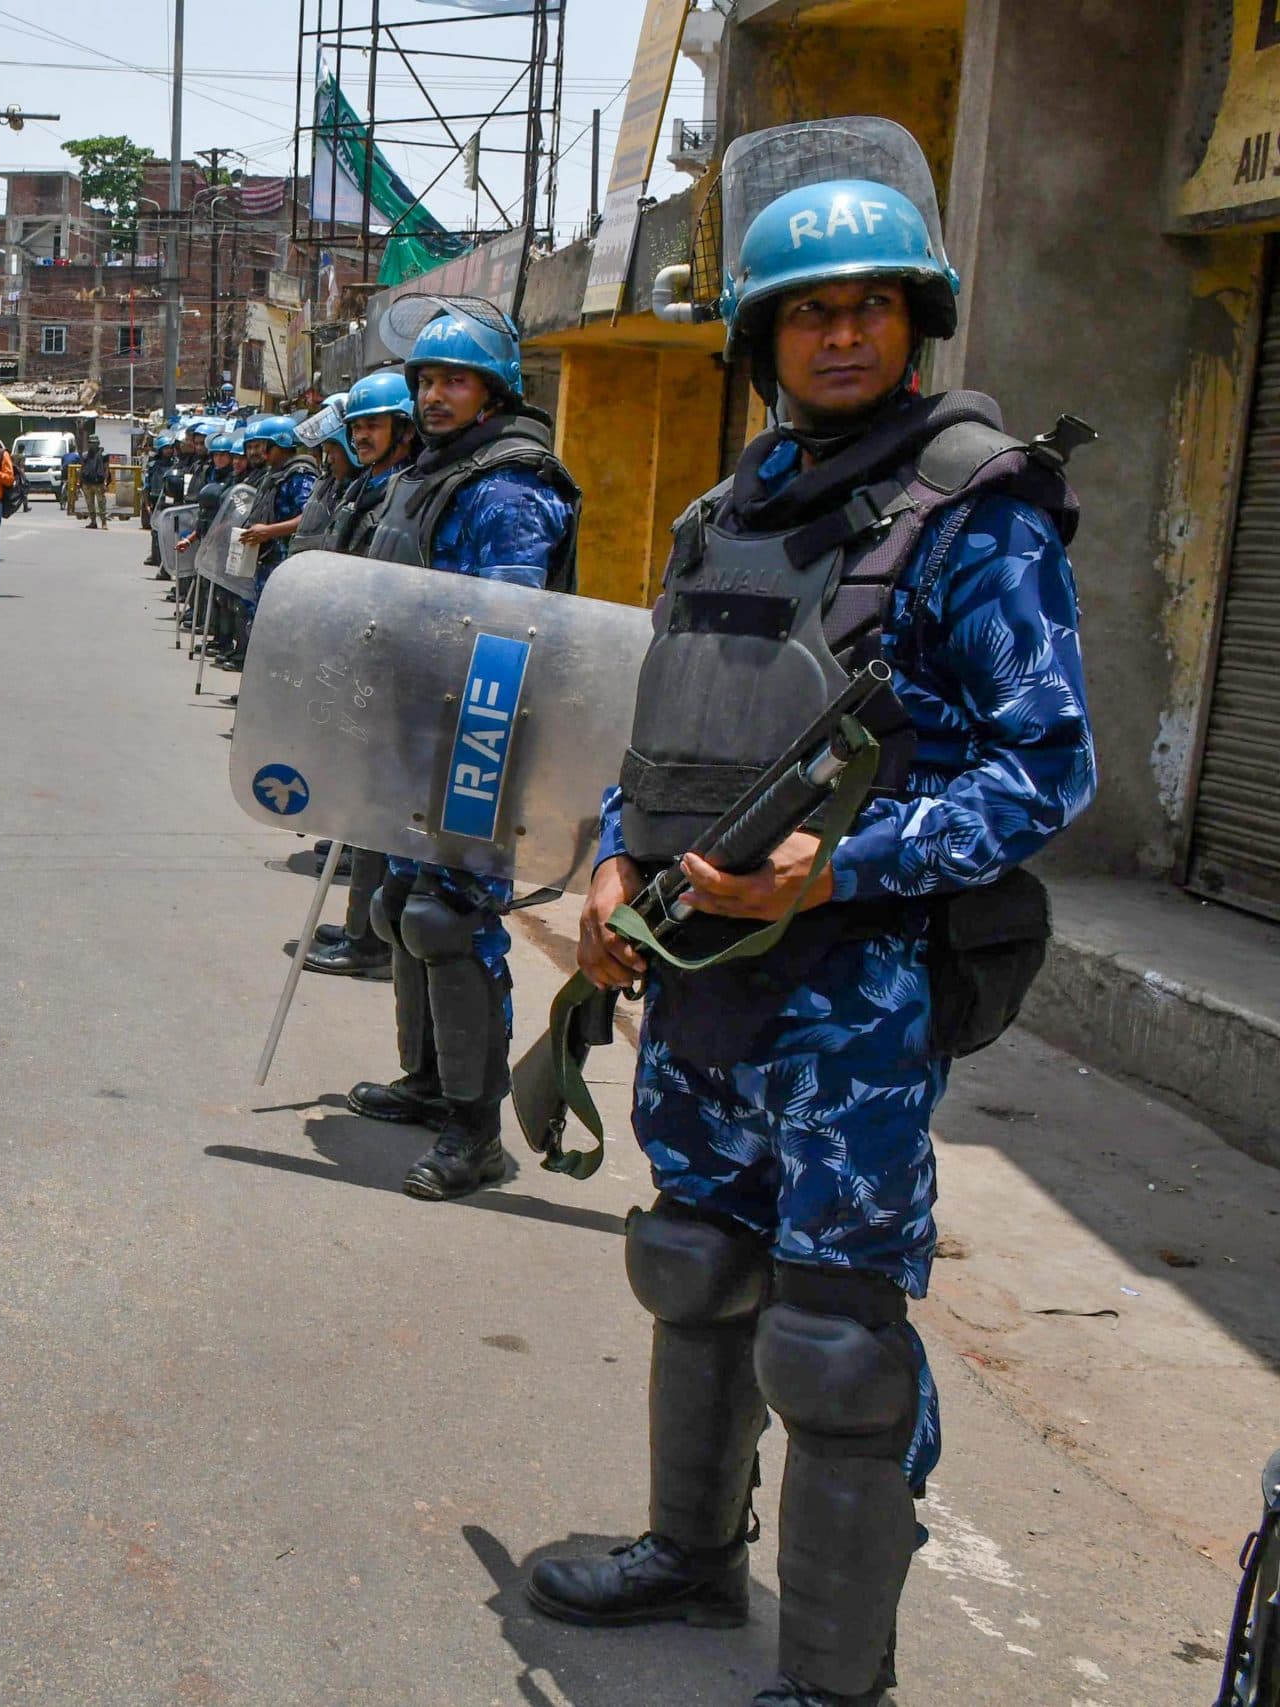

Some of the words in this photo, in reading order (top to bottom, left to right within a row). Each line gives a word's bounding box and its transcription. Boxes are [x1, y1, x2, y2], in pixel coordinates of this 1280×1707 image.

[1234, 132, 1271, 185] All
[789, 199, 888, 249] RAF
[452, 677, 510, 802] RAF
